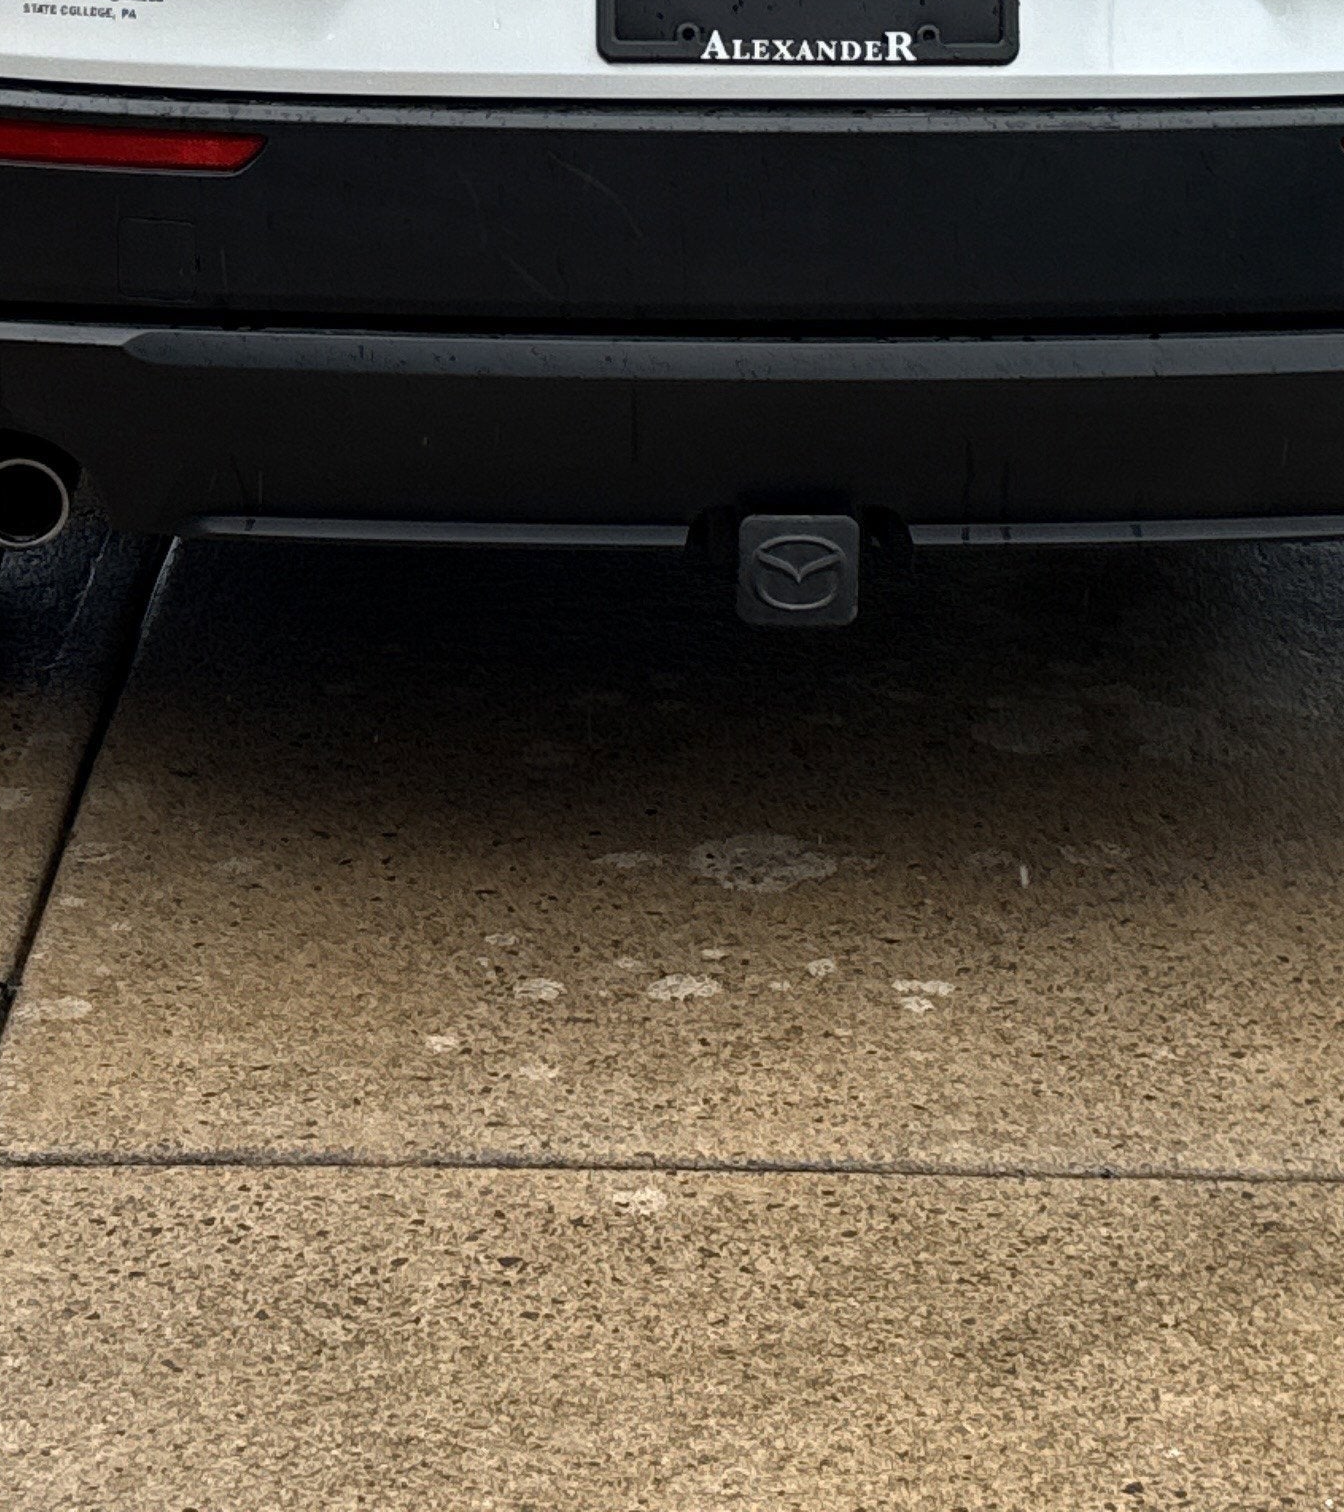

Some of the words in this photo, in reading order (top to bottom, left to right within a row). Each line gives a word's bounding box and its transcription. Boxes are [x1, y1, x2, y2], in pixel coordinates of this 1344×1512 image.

[22, 2, 57, 15] STATE
[121, 8, 137, 19] PA
[700, 29, 918, 62] ALEXANDER
